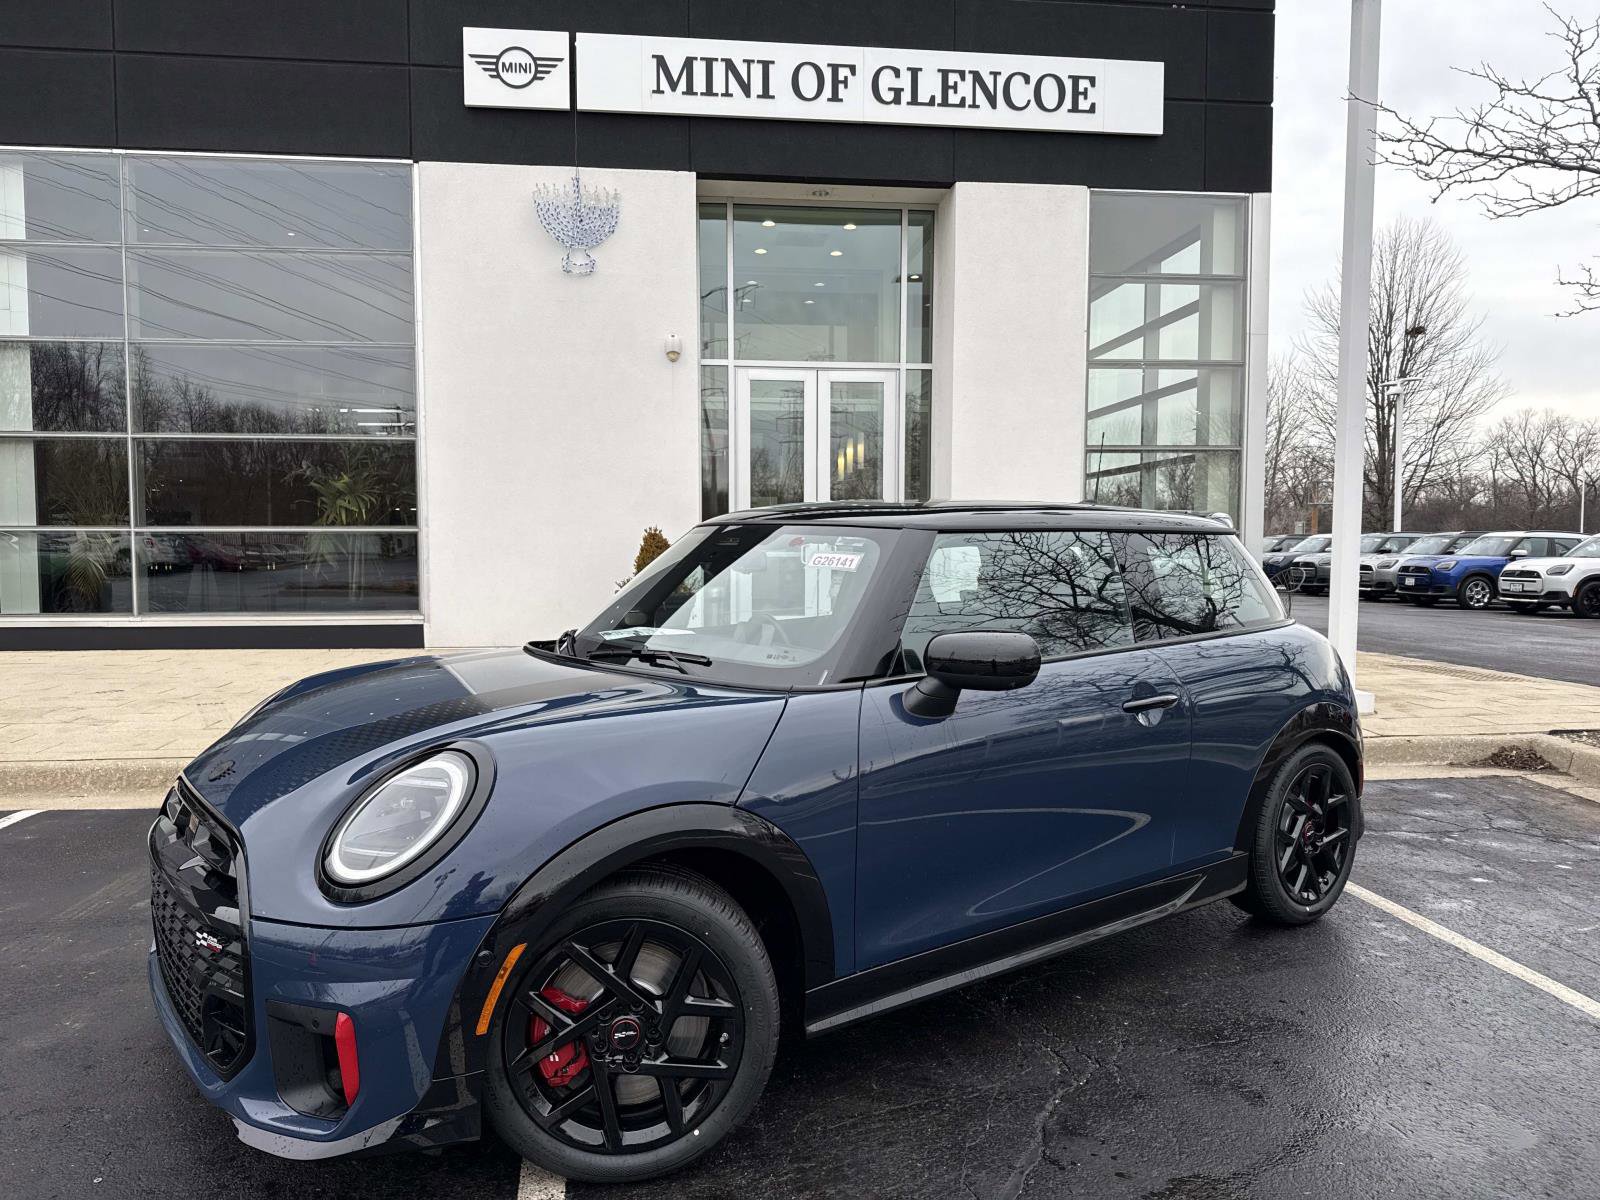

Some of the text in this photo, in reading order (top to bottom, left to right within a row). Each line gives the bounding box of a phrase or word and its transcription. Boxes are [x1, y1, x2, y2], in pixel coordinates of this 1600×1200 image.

[501, 61, 532, 74] MINI
[651, 54, 1097, 115] MINI OF GLENCOE
[812, 556, 856, 568] G26141
